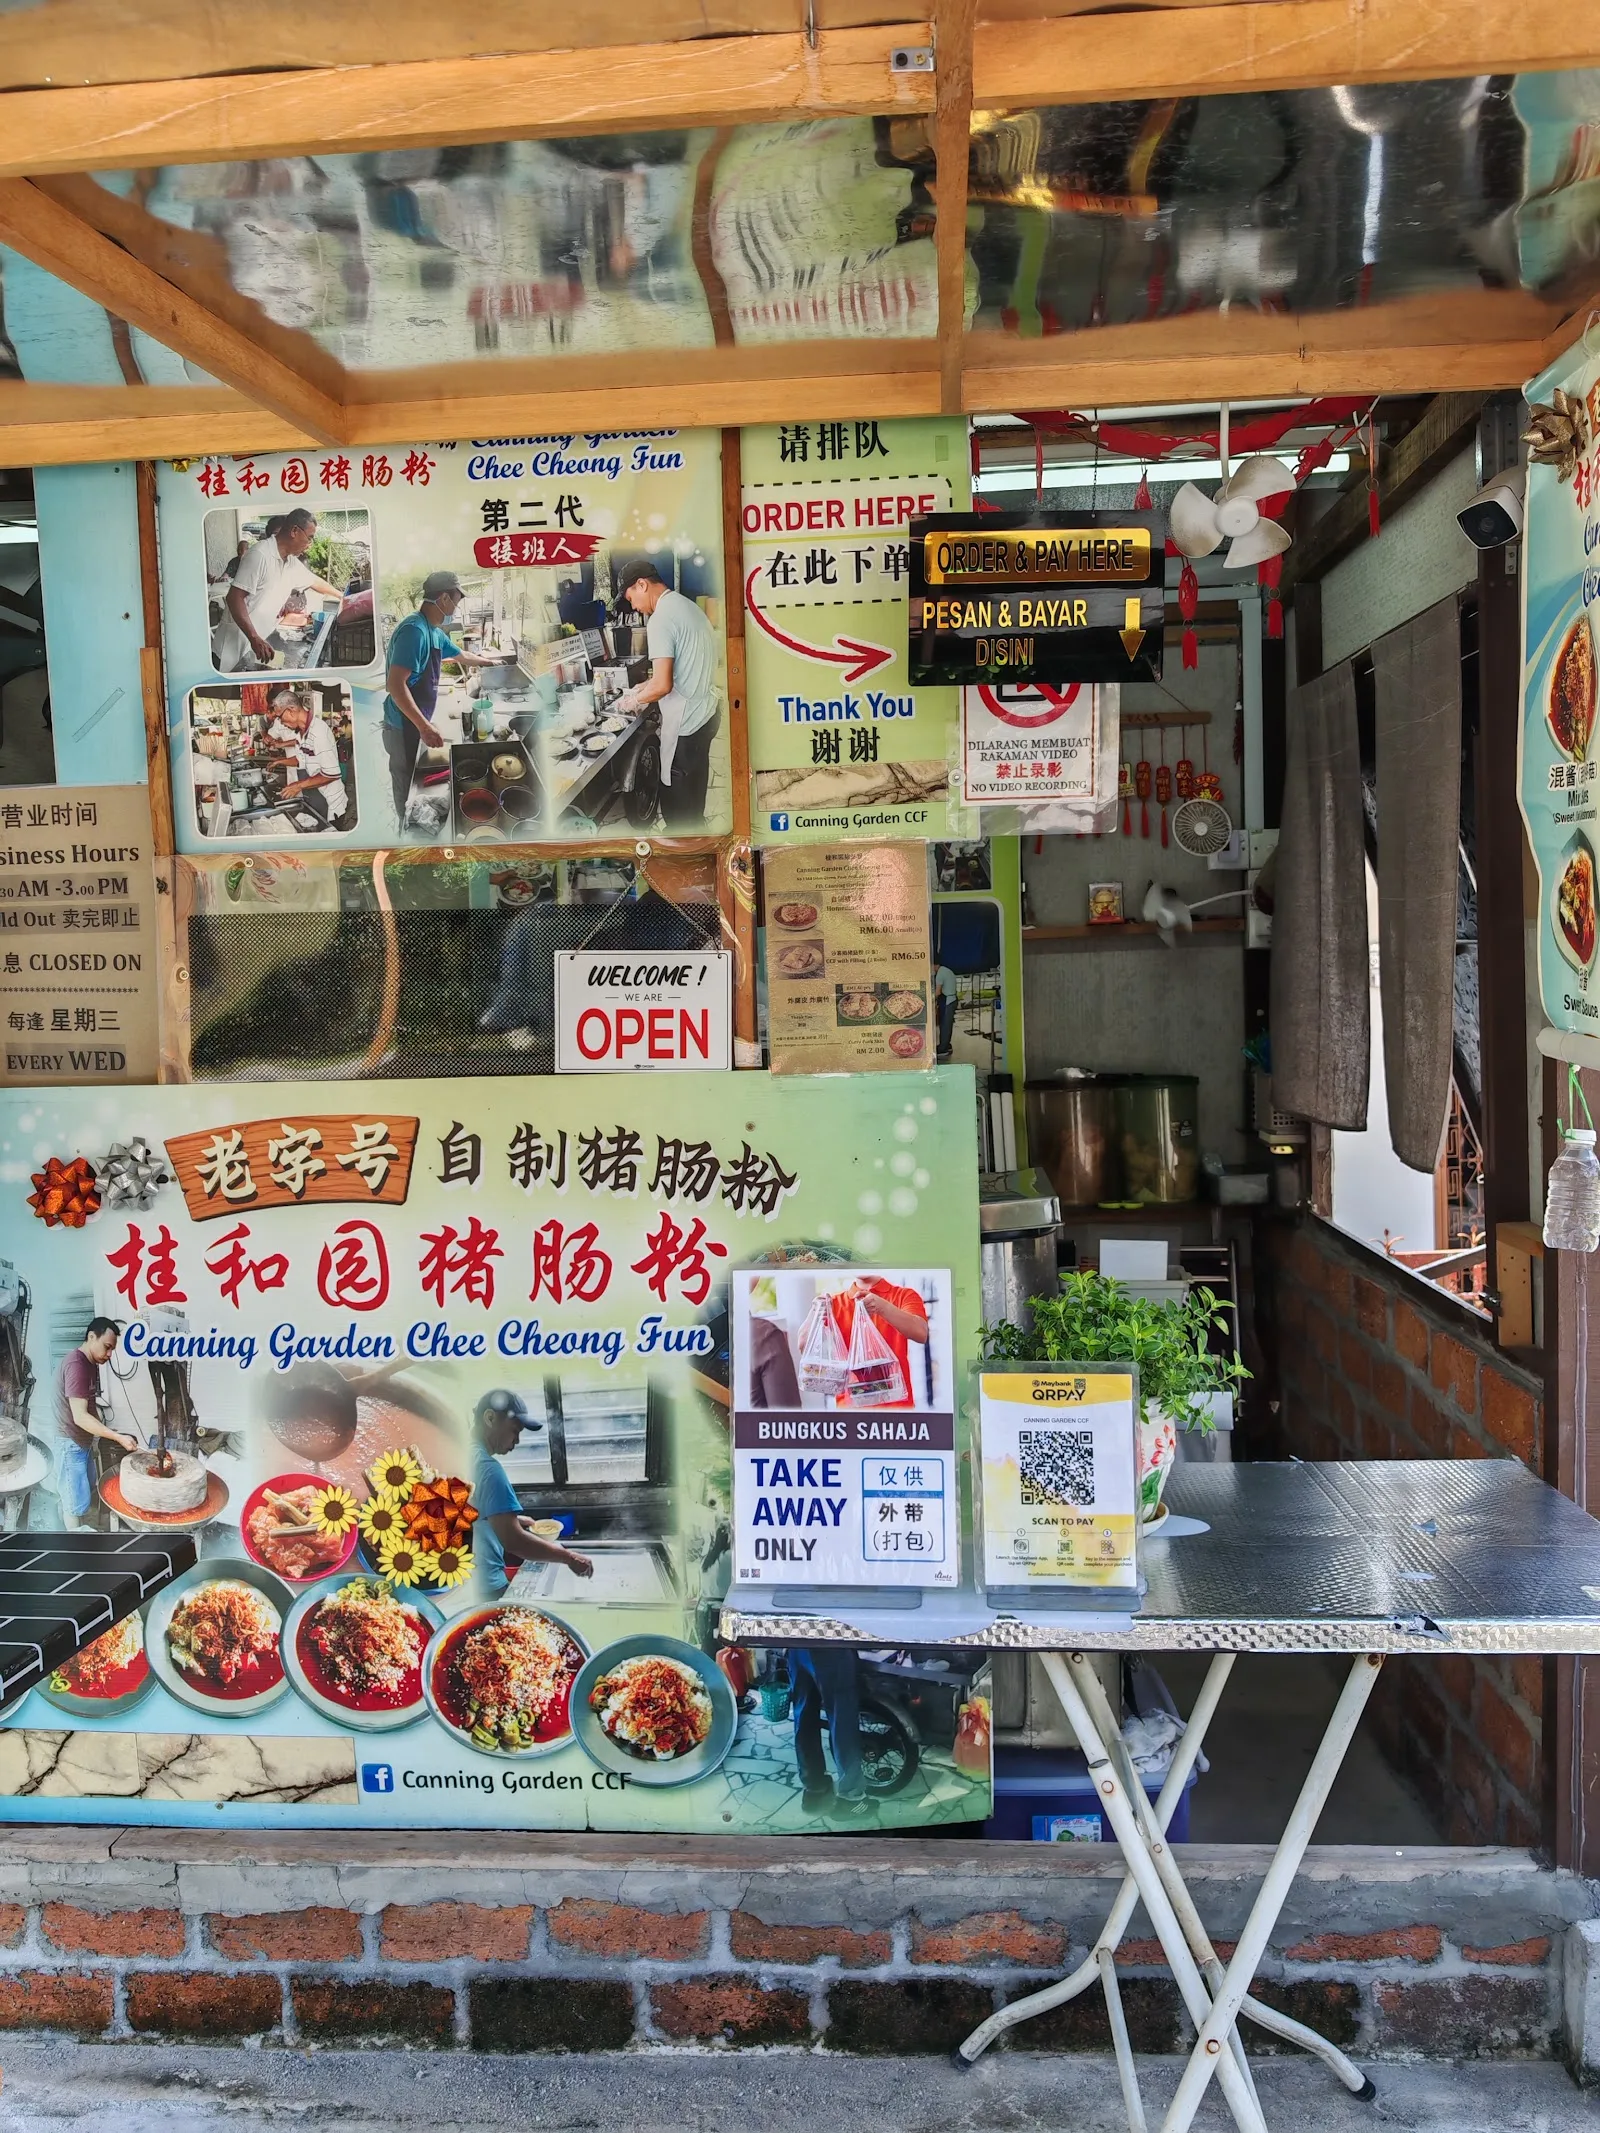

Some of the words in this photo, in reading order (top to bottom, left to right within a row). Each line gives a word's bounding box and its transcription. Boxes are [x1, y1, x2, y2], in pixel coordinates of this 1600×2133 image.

[778, 421, 890, 463] 请排队
[196, 449, 437, 500] 桂和园猪肠粉
[467, 455, 525, 480] Chee
[531, 451, 623, 480] Cheong
[631, 445, 683, 471] Fun
[480, 495, 585, 533] 第二代
[743, 500, 845, 533] ORDER
[490, 536, 581, 563] 接班人
[938, 541, 1008, 575] ORDER
[1016, 542, 1028, 573] &
[1035, 540, 1074, 572] PAY
[1079, 539, 1133, 571] HERE
[765, 544, 910, 588] 在此下单
[923, 600, 992, 629] PESAN
[998, 601, 1013, 627] &
[1018, 600, 1088, 627] BAYAR
[975, 638, 1034, 667] DISINI
[778, 696, 860, 723] Thank
[866, 693, 913, 718] You
[810, 727, 880, 764] 谢谢
[968, 740, 1028, 751] DILARANG
[1031, 738, 1090, 749] MEMBUAT
[980, 751, 1038, 761] RAKAMAN
[1041, 749, 1078, 759] VIDEO
[996, 762, 1063, 779] 禁止录影
[971, 784, 986, 792] NO
[989, 782, 1022, 791] VIDEO
[1025, 781, 1087, 791] RECORDING
[1, 802, 97, 828] 营业时间
[796, 815, 848, 828] Canning
[853, 813, 899, 828] Garden
[905, 811, 928, 822] CCF
[71, 844, 139, 865] Hours
[17, 880, 49, 897] AM
[98, 877, 128, 895] PM
[23, 911, 56, 928] Out
[62, 908, 139, 929] 卖完即止
[860, 926, 893, 934] RM6.00
[29, 954, 106, 971] CLOSED
[113, 954, 141, 971] ON
[892, 952, 925, 960] RM6.50
[7, 1011, 44, 1031] 每逢
[50, 1008, 121, 1032] 星期三
[576, 1008, 709, 1060] OPEN
[7, 1054, 63, 1070] EVERY
[69, 1050, 126, 1071] WED
[195, 1123, 399, 1201] 老字号
[437, 1121, 797, 1216] 自制猪肠粉
[106, 1213, 729, 1312] 桂和园猪肠粉
[124, 1322, 259, 1368] Canning
[269, 1322, 397, 1368] Garden
[406, 1320, 488, 1358] Chee
[498, 1319, 624, 1364] Cheong
[637, 1317, 715, 1352] Fun
[1032, 1389, 1085, 1400] QRPAY
[758, 1421, 847, 1440] BUNGKUS
[856, 1421, 930, 1440] SAHAJA
[750, 1459, 841, 1487] TAKE
[879, 1466, 924, 1486] 仅供
[752, 1498, 847, 1526] AWAY
[878, 1503, 923, 1524] 外带
[754, 1538, 817, 1561] ONLY
[872, 1530, 934, 1552] (打包)
[403, 1770, 494, 1794] Canning
[502, 1770, 583, 1794] Garden
[591, 1772, 632, 1790] CCF
